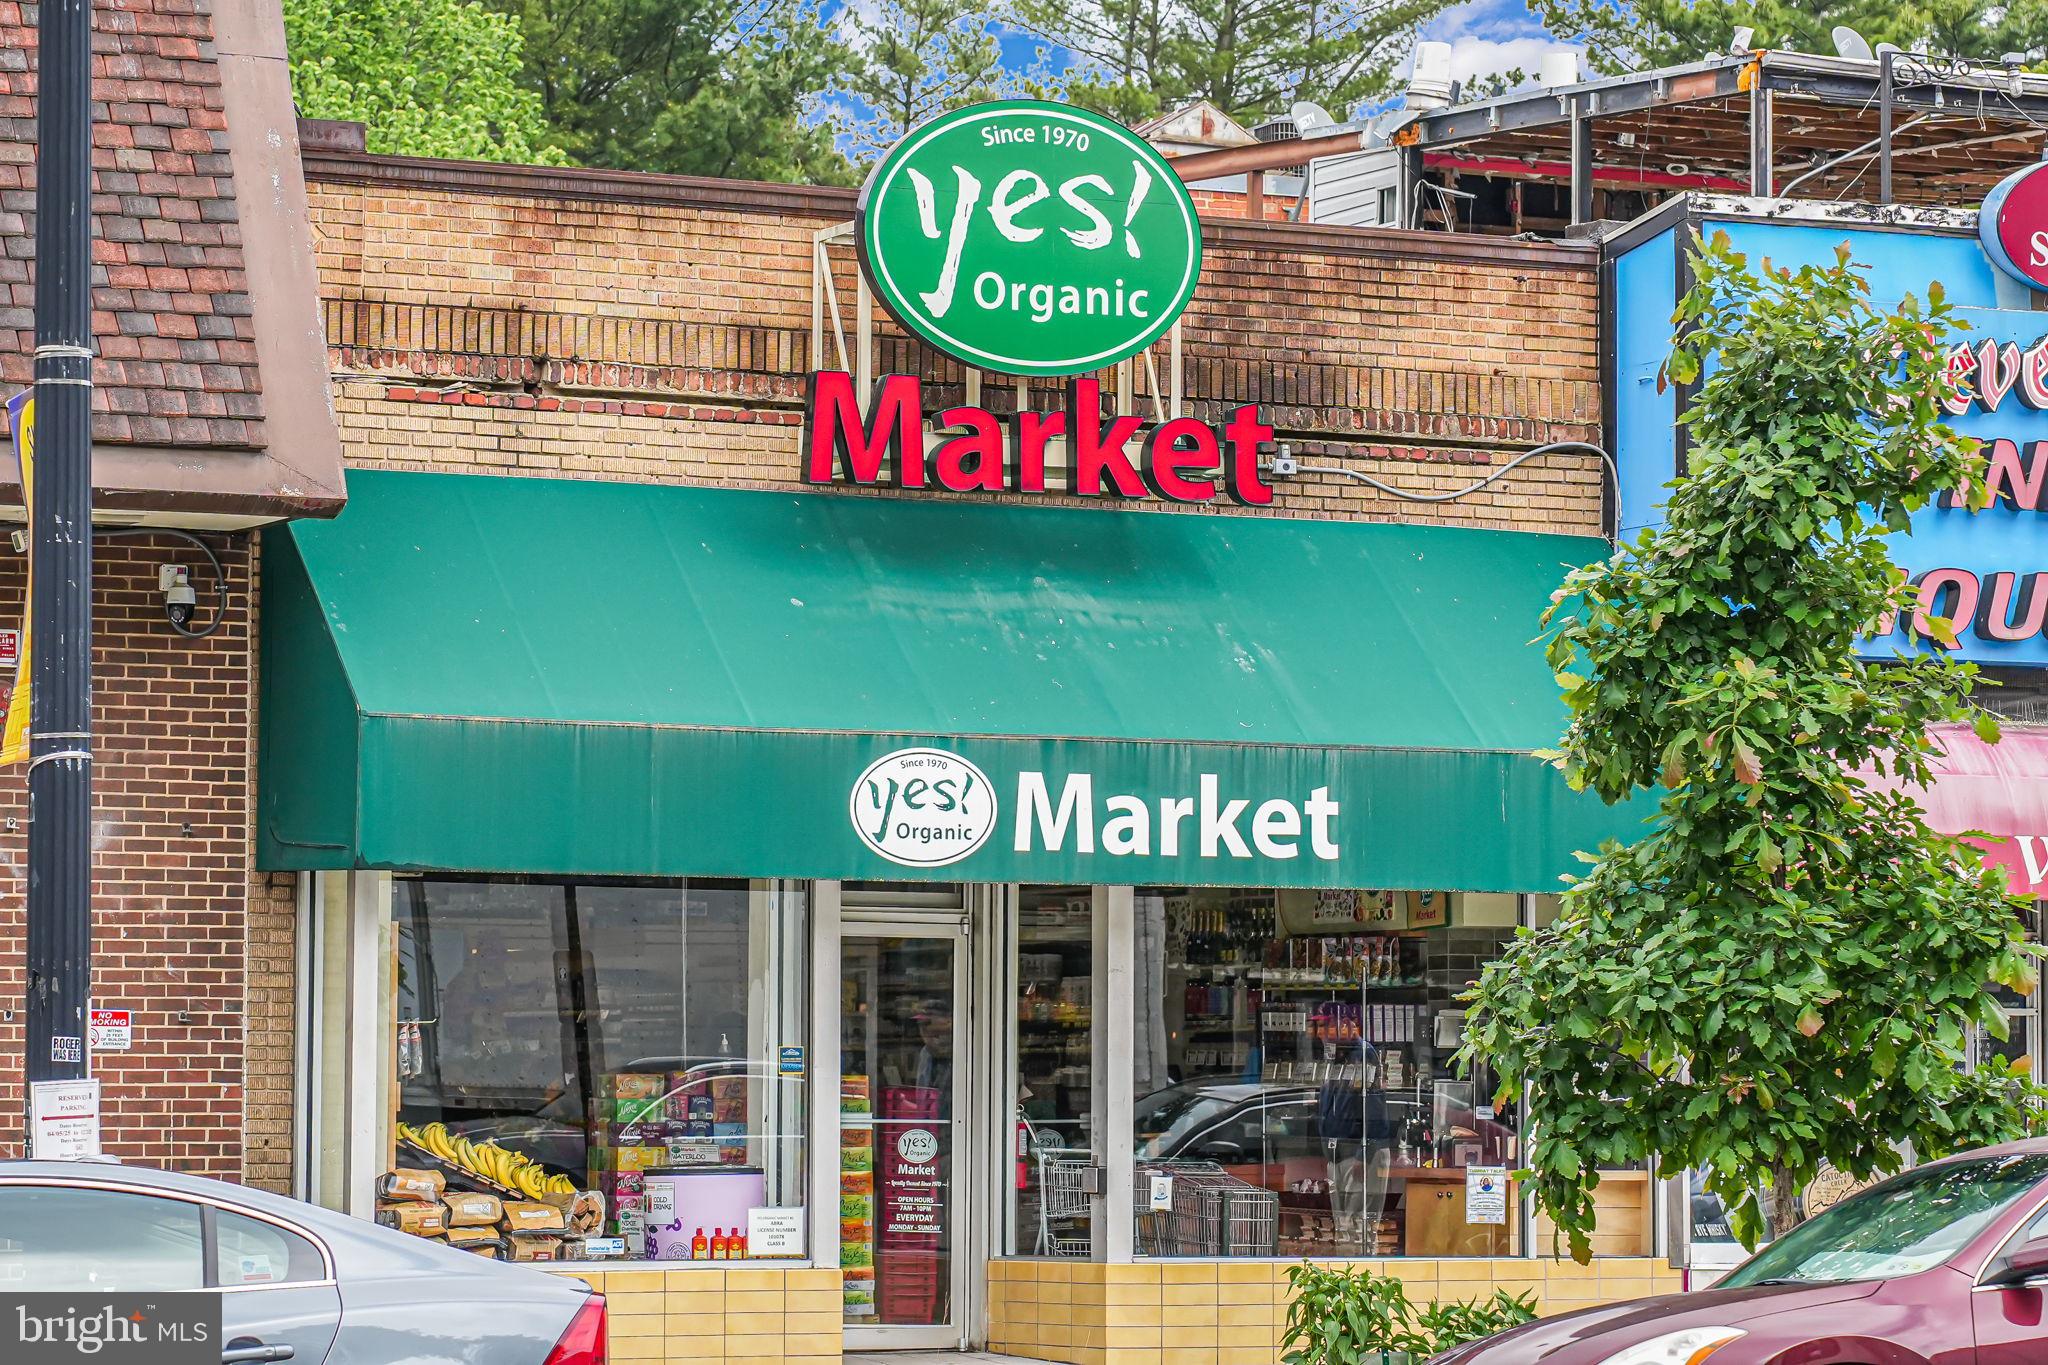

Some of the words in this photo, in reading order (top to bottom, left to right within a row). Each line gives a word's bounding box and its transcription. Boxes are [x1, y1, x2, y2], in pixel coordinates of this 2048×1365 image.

[981, 125, 1036, 148] Since
[1042, 125, 1090, 152] 1970
[906, 159, 1152, 318] yes!
[973, 271, 1149, 322] Organic
[806, 370, 1274, 505] Market
[900, 758, 925, 770] Since
[926, 758, 948, 770] 1970
[867, 772, 973, 843] yes!
[1013, 771, 1339, 860] Market
[896, 822, 973, 844] Organic
[91, 1018, 127, 1026] MOKING
[53, 1037, 80, 1049] ROGER
[53, 1049, 67, 1060] WAS
[903, 1137, 932, 1156] yes!
[898, 1164, 936, 1176] Market
[896, 1213, 934, 1222] EVERYDAY
